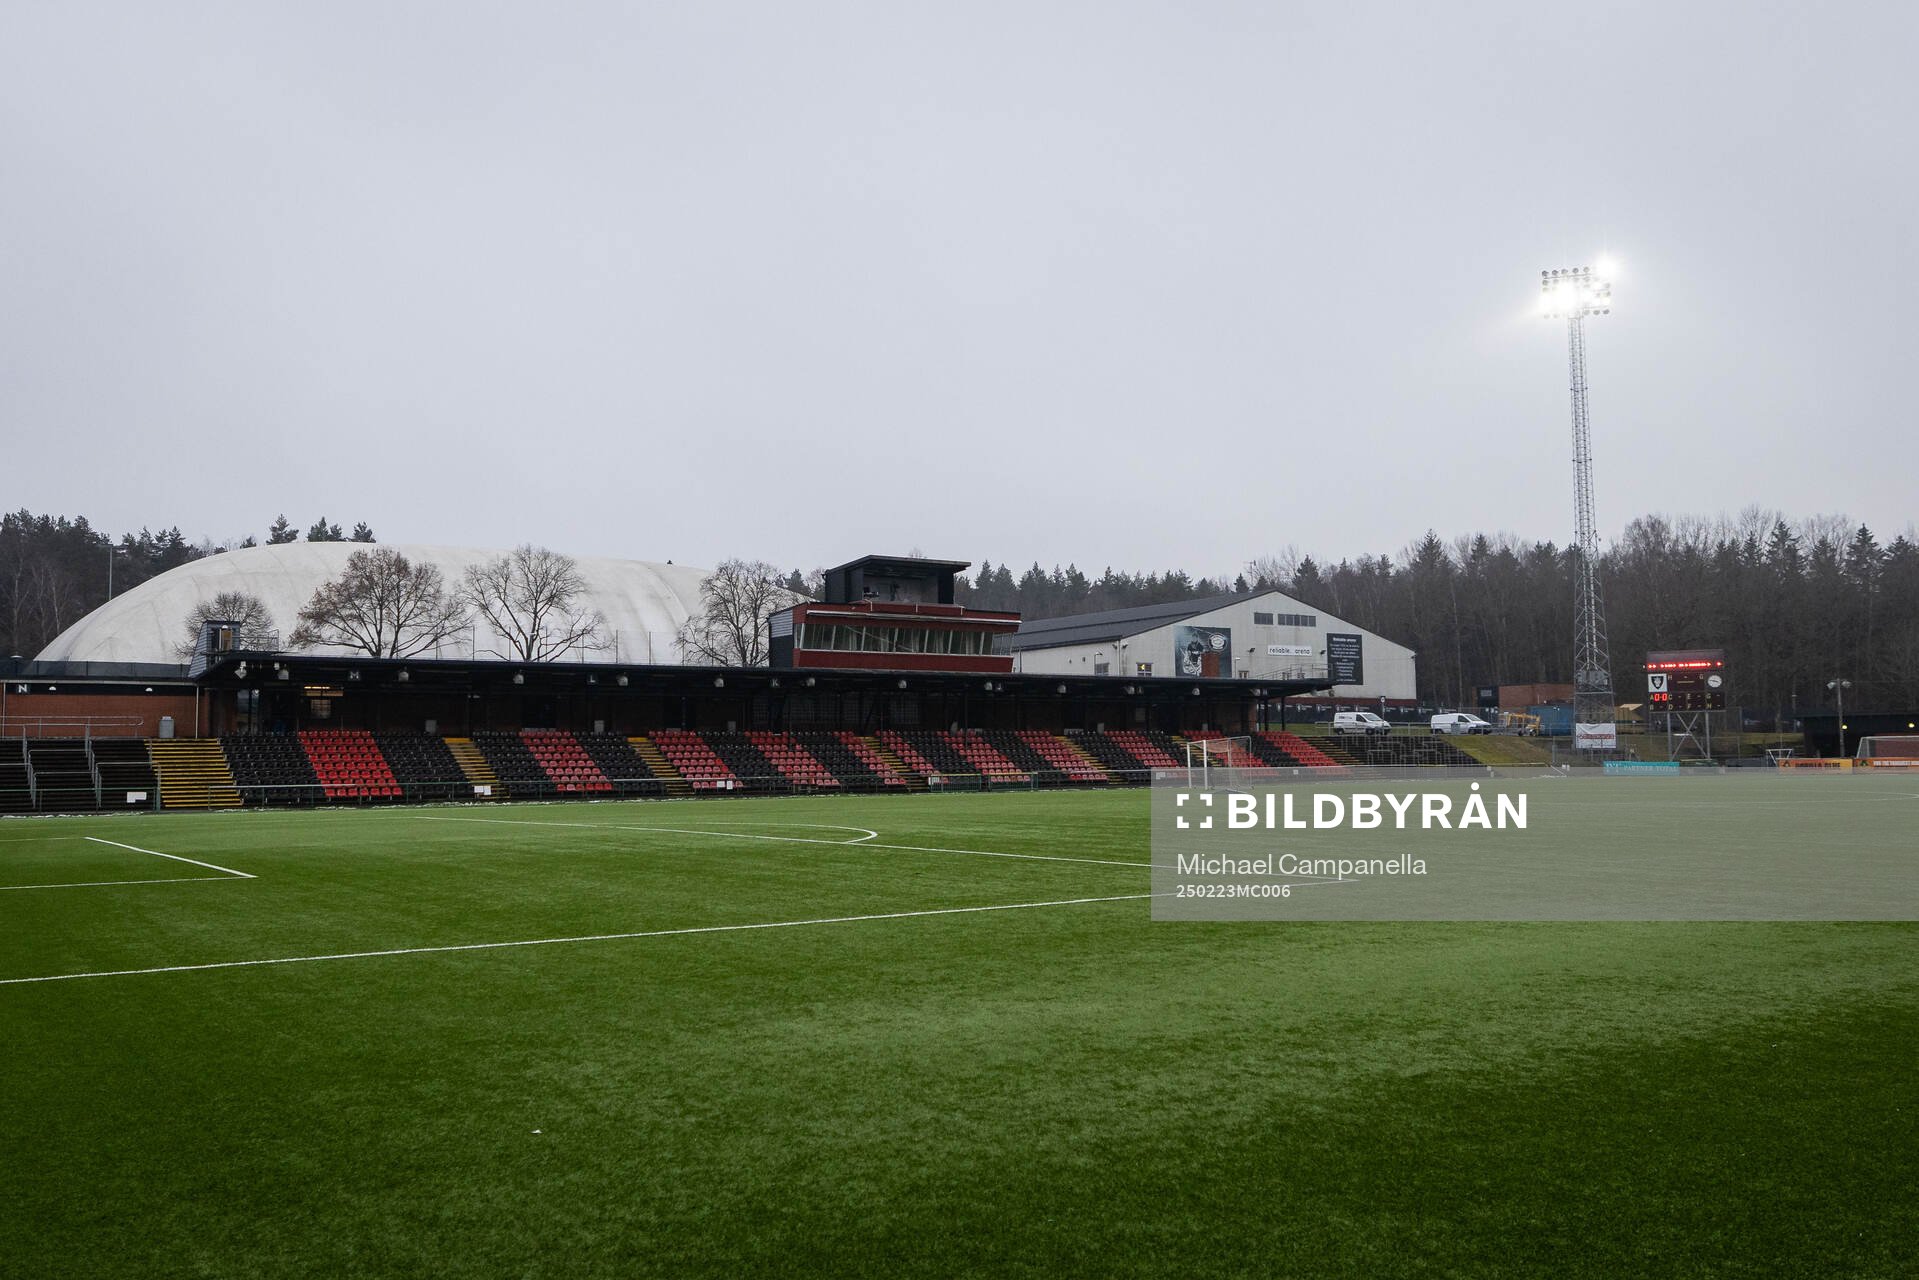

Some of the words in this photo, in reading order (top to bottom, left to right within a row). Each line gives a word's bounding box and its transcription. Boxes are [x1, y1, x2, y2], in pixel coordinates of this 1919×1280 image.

[349, 671, 359, 679] M
[772, 678, 779, 687] K
[18, 684, 27, 693] N
